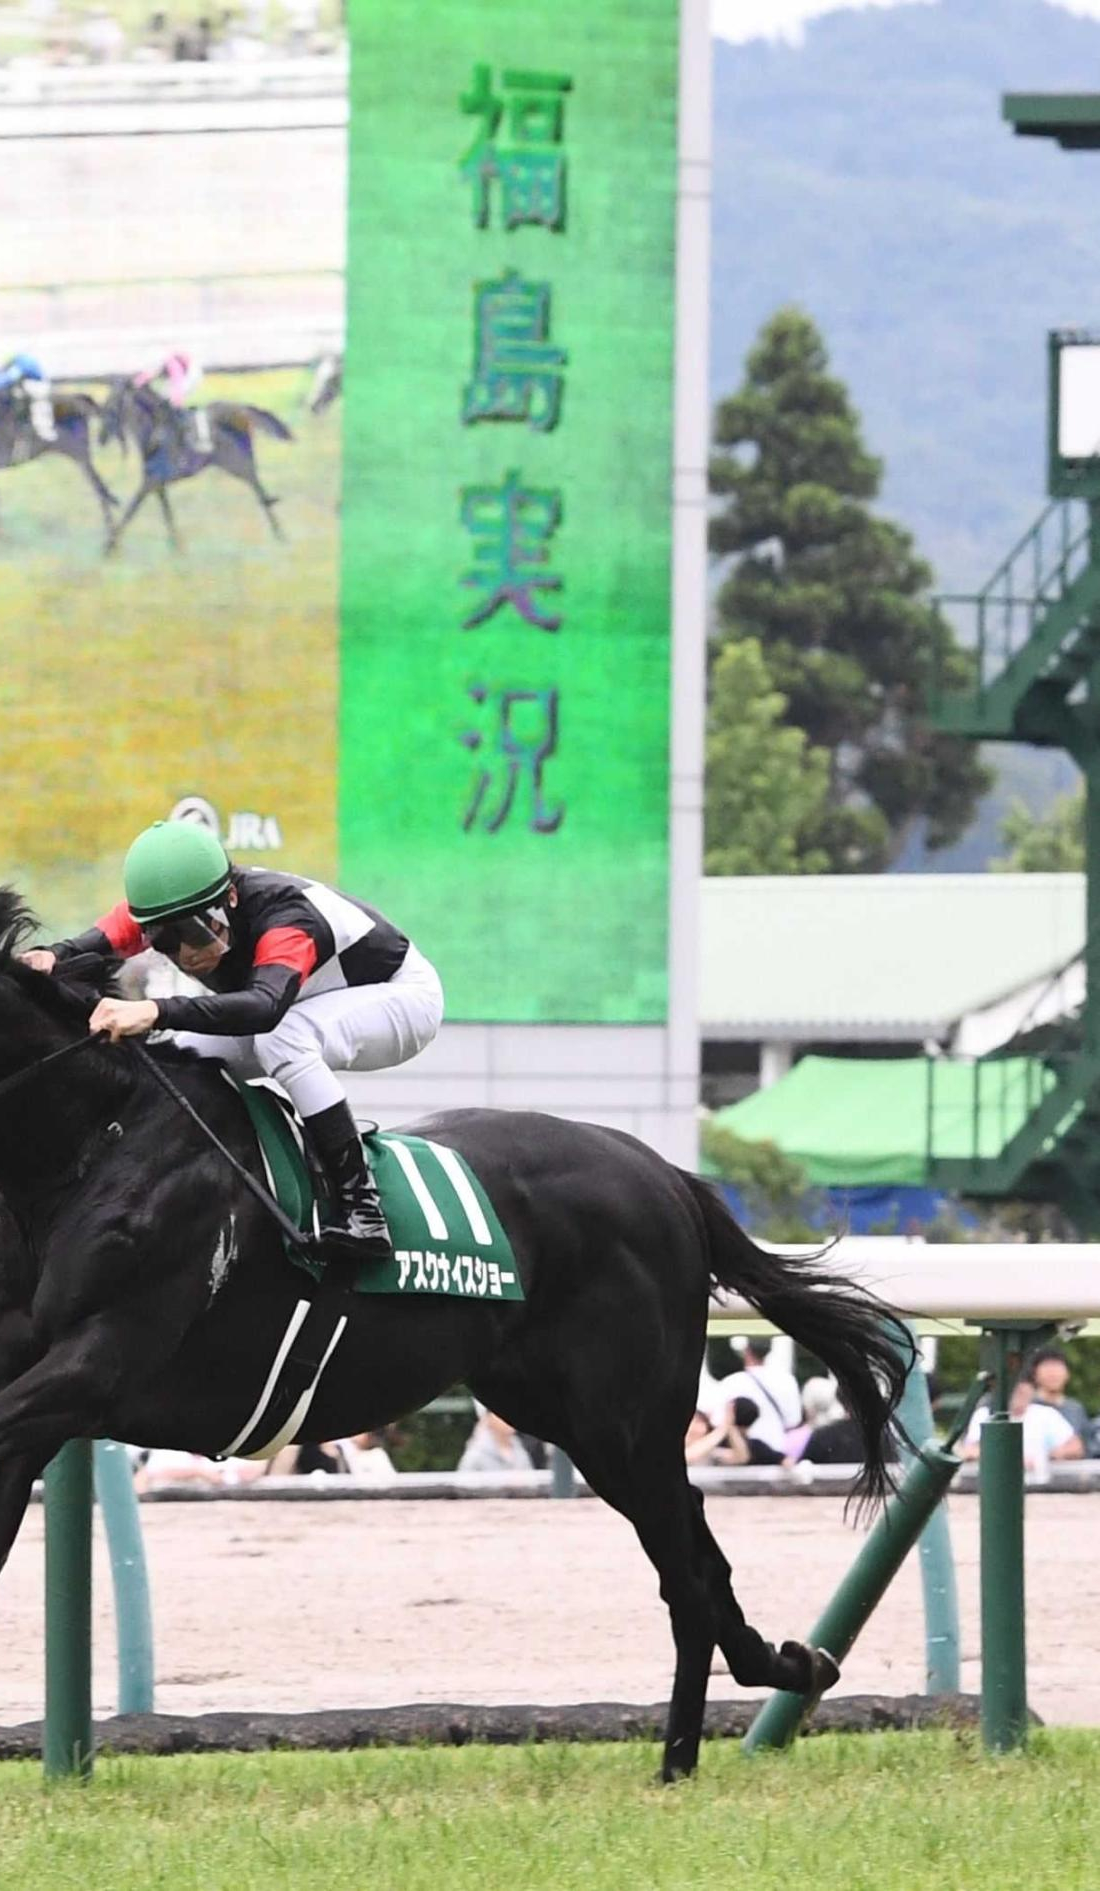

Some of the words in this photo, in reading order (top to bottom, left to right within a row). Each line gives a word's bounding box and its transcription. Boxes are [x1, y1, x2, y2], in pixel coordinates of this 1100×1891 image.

[458, 64, 573, 835] 福島実況
[225, 811, 283, 850] JRA
[381, 1138, 493, 1246] 11
